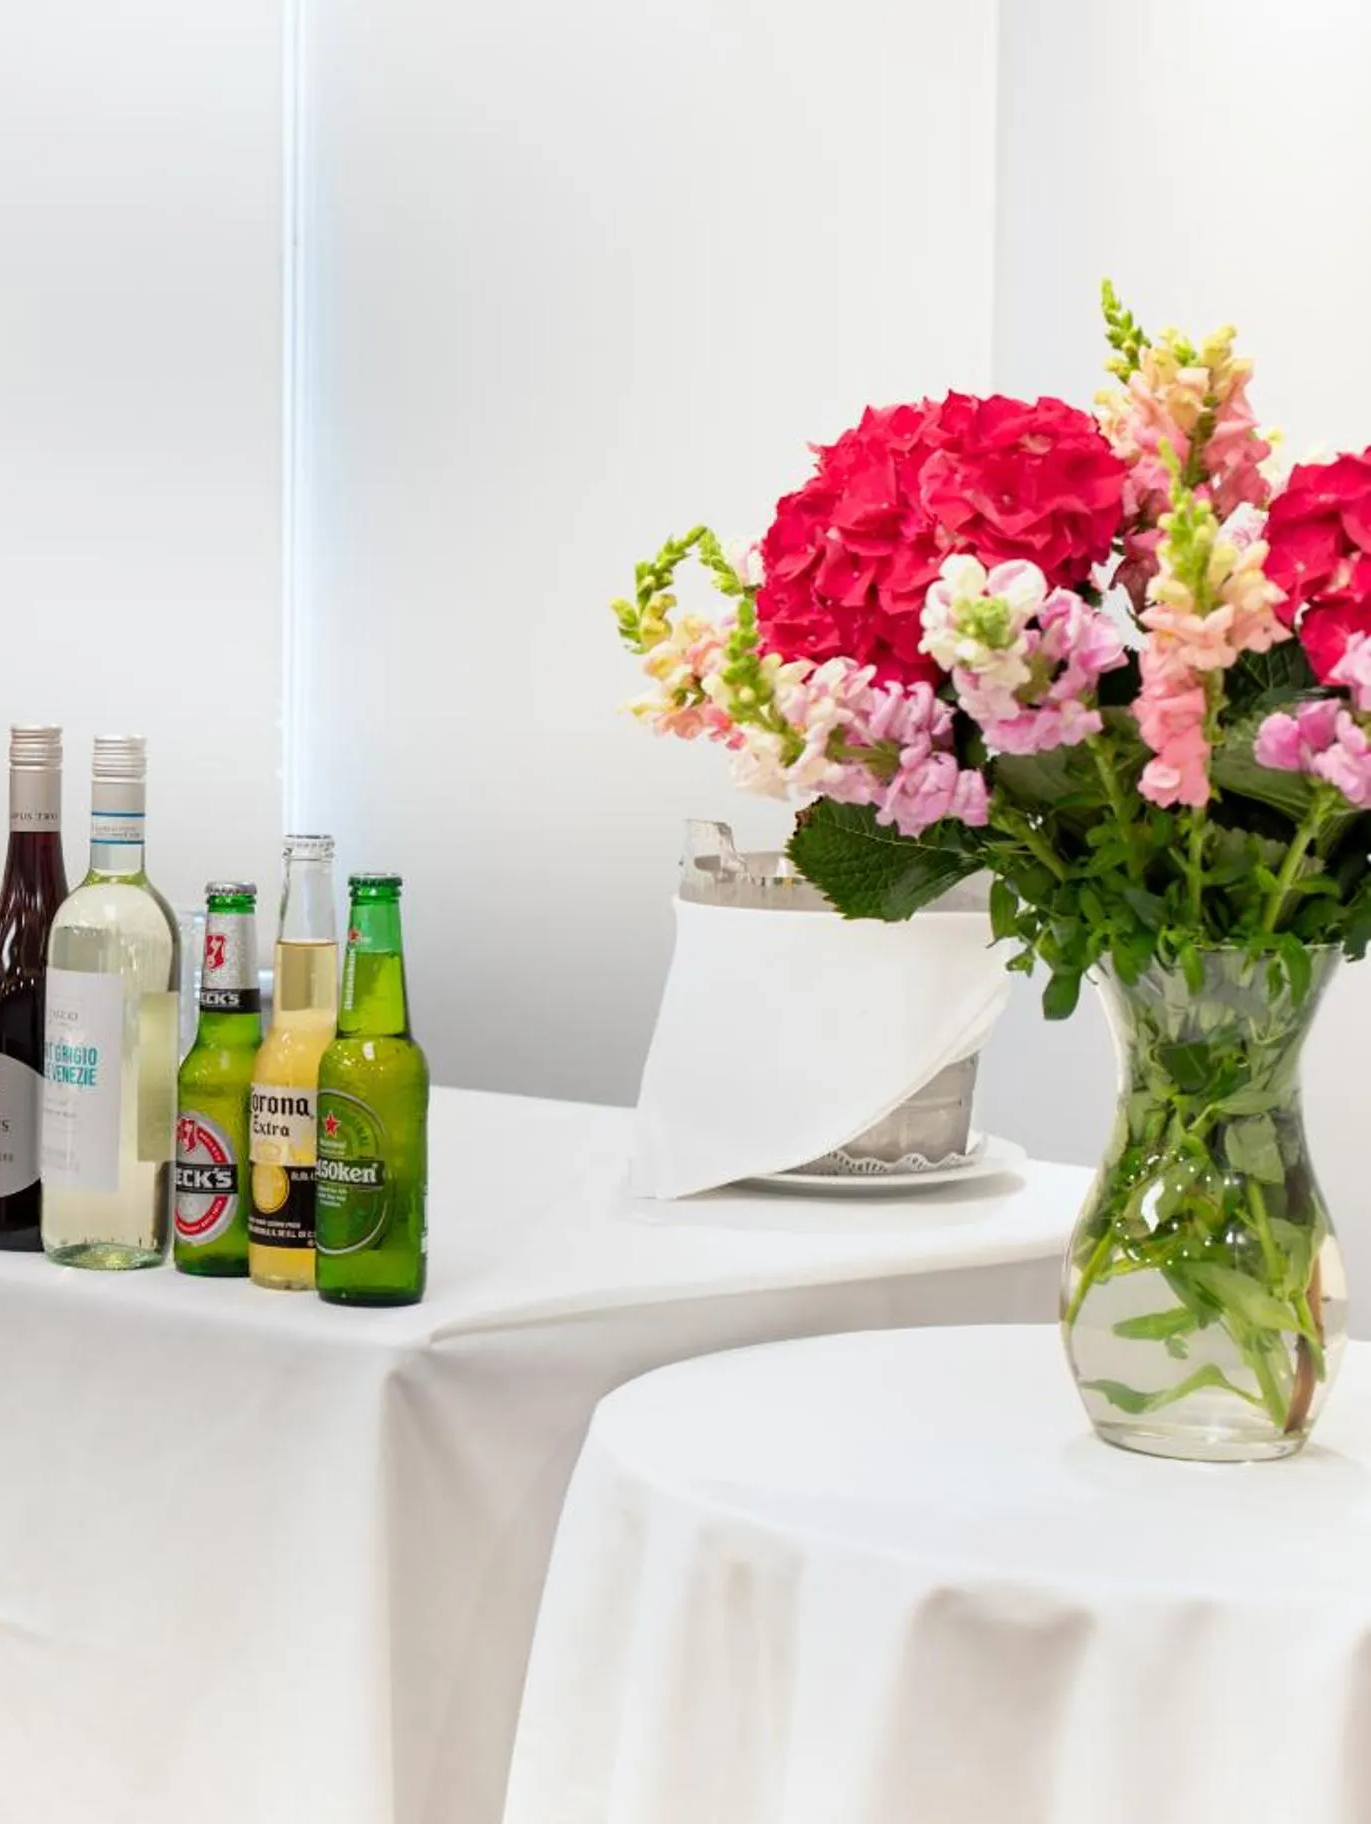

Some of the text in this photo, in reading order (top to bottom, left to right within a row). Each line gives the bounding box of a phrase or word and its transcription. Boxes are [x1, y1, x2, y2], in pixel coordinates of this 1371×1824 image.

[55, 1044, 97, 1066] GRIGIO
[52, 1065, 97, 1087] VENEZIE
[251, 1092, 311, 1117] orona
[253, 1115, 290, 1137] Extra
